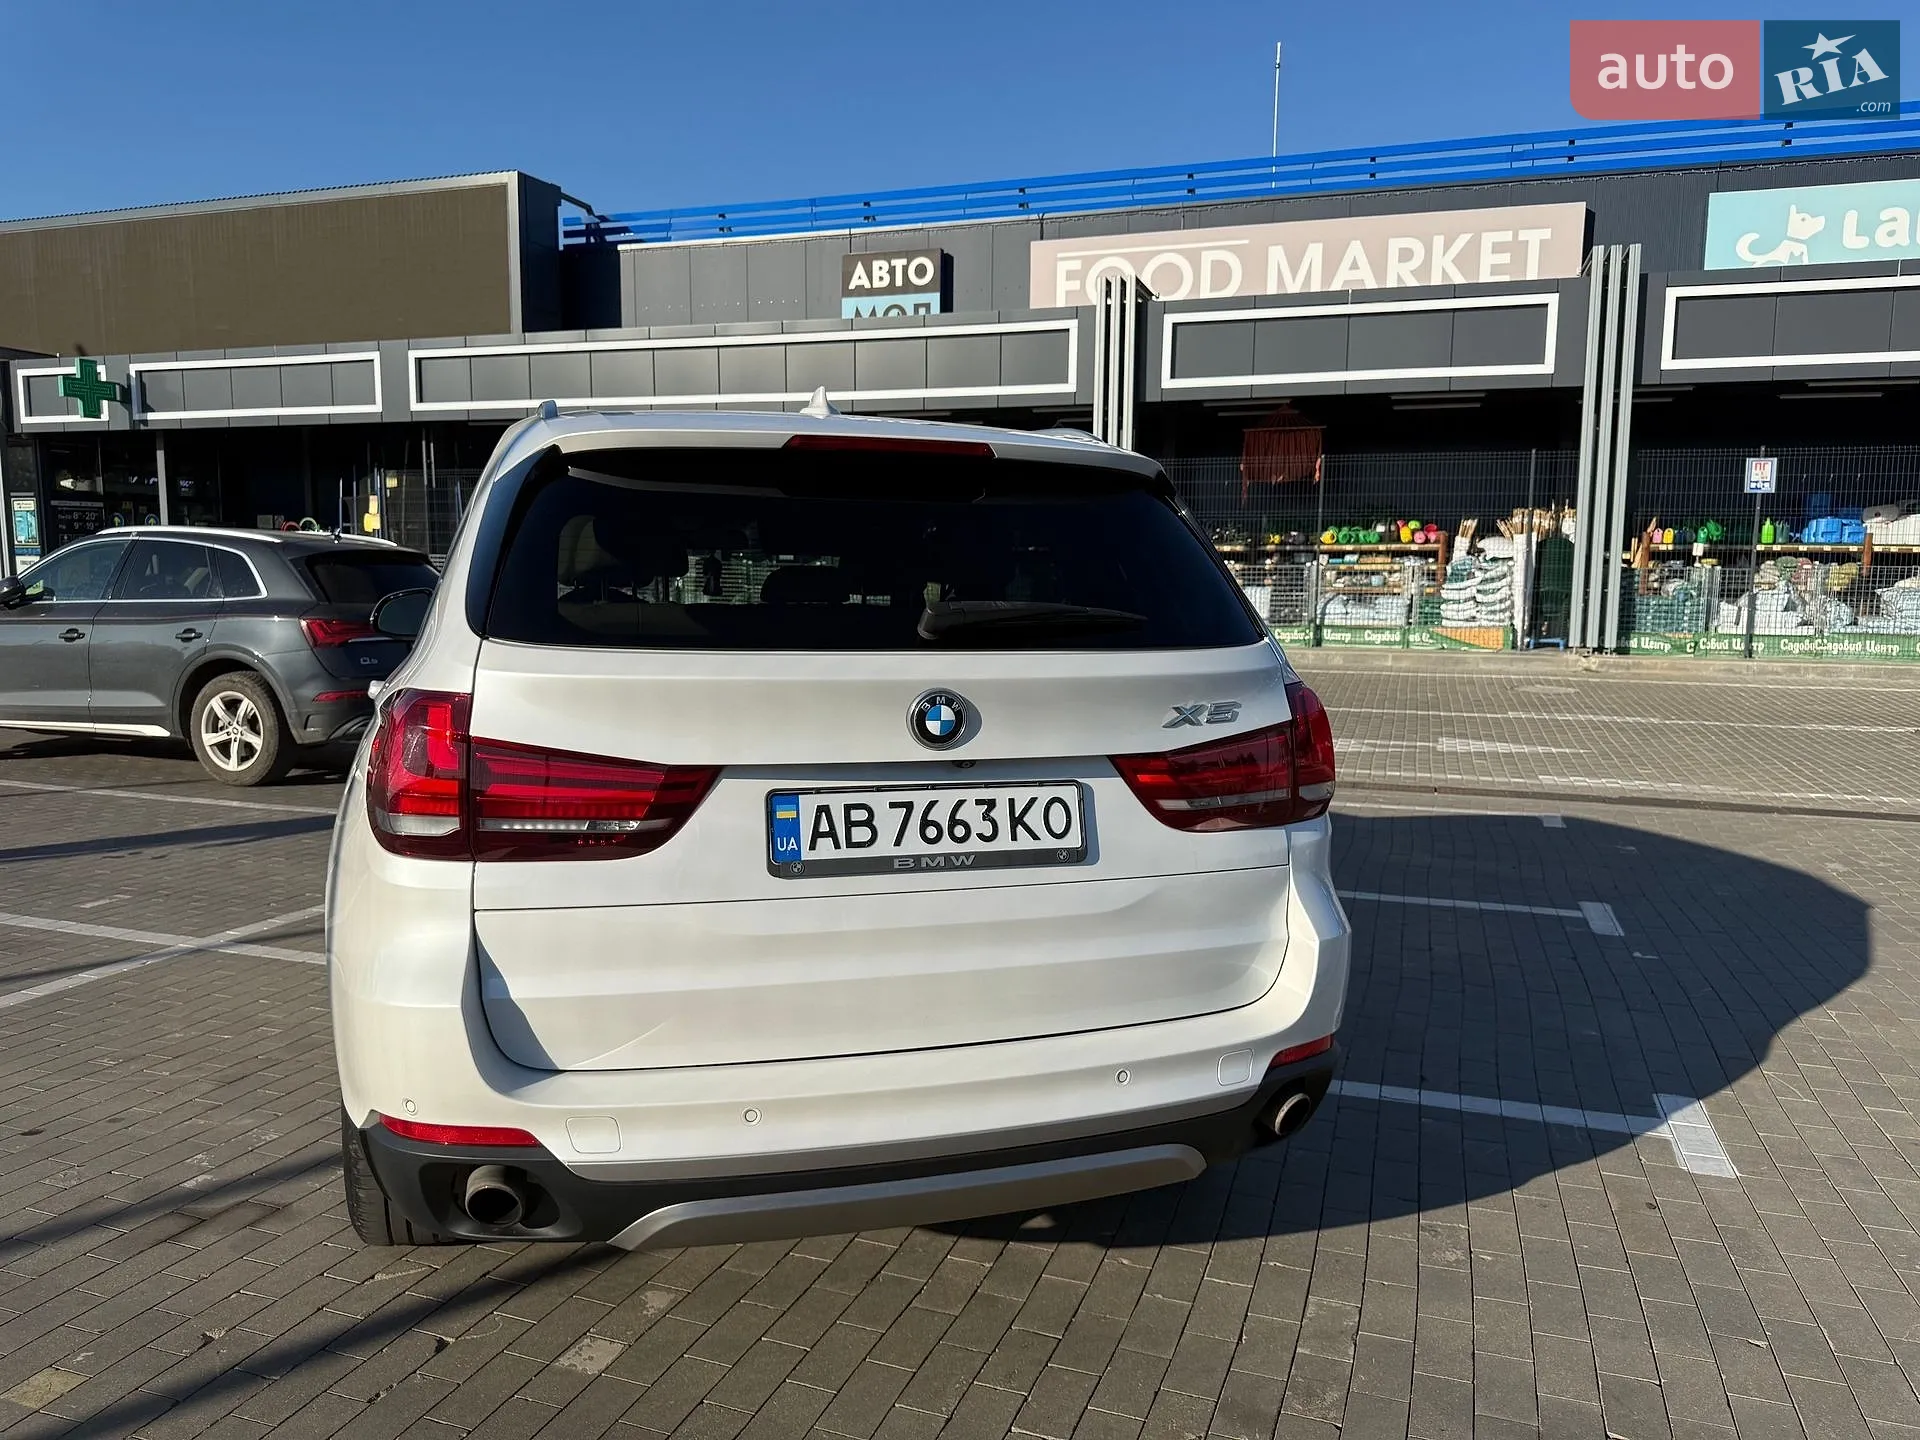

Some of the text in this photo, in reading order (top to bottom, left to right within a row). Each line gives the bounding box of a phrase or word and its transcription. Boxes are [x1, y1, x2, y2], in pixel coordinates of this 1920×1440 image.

[1842, 206, 1920, 249] La
[848, 256, 935, 290] АВТО
[1055, 228, 1552, 308] FOOD MARKET
[921, 696, 961, 713] BMW
[1161, 701, 1242, 729] X5
[808, 796, 1072, 851] AB 7663 KO
[777, 837, 798, 851] UA
[893, 854, 976, 869] BMW
